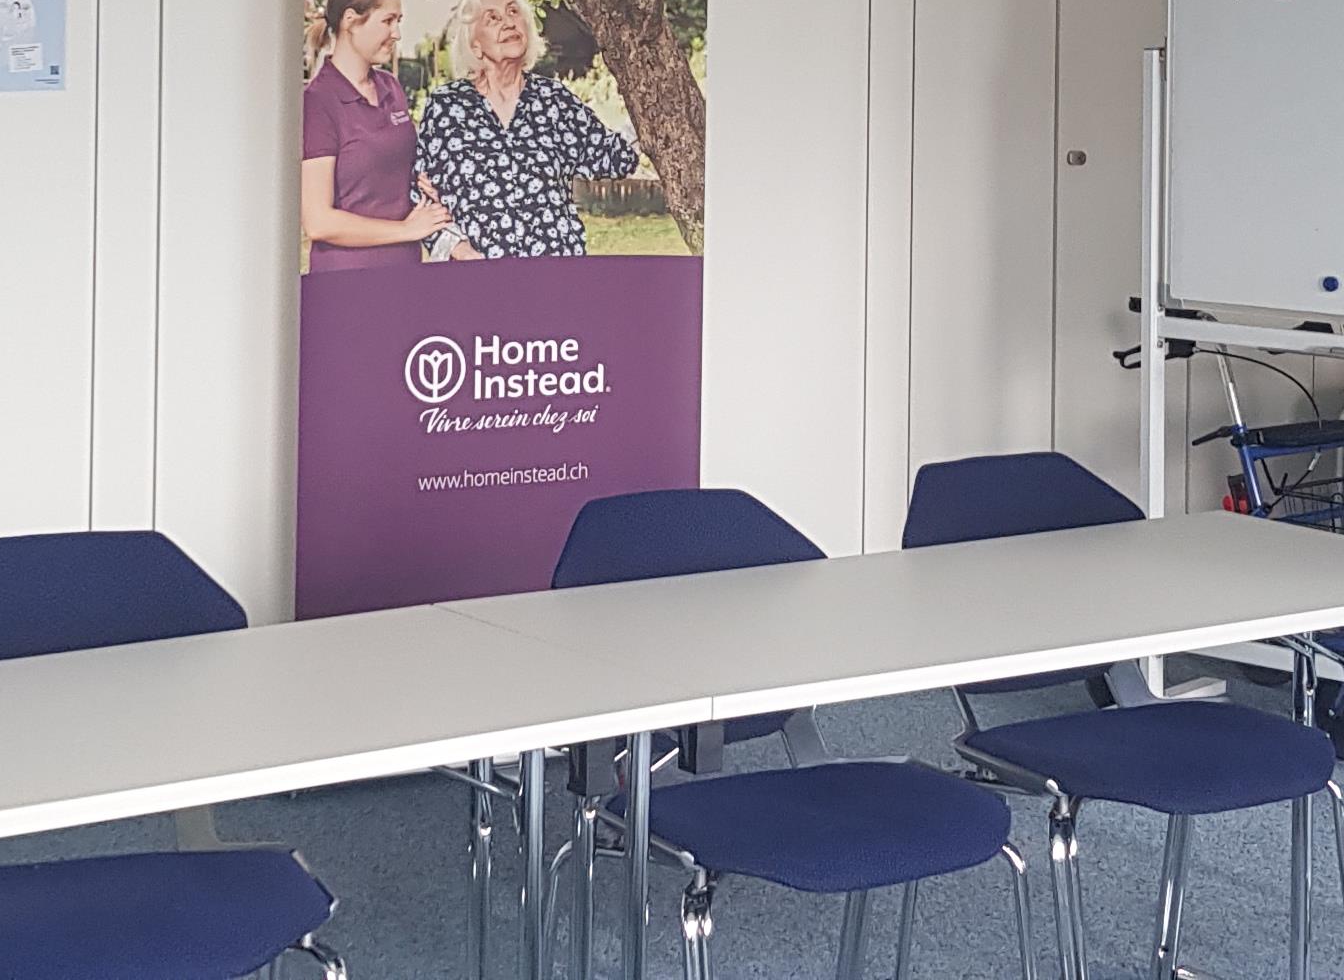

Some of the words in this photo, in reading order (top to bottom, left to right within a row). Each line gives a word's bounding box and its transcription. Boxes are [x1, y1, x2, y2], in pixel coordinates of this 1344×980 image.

[474, 334, 579, 366] Home
[419, 407, 473, 434] Vivre
[471, 409, 530, 431] serein
[531, 404, 568, 434] chez
[568, 404, 600, 424] soi
[417, 461, 589, 491] www.homeinstead.ch
